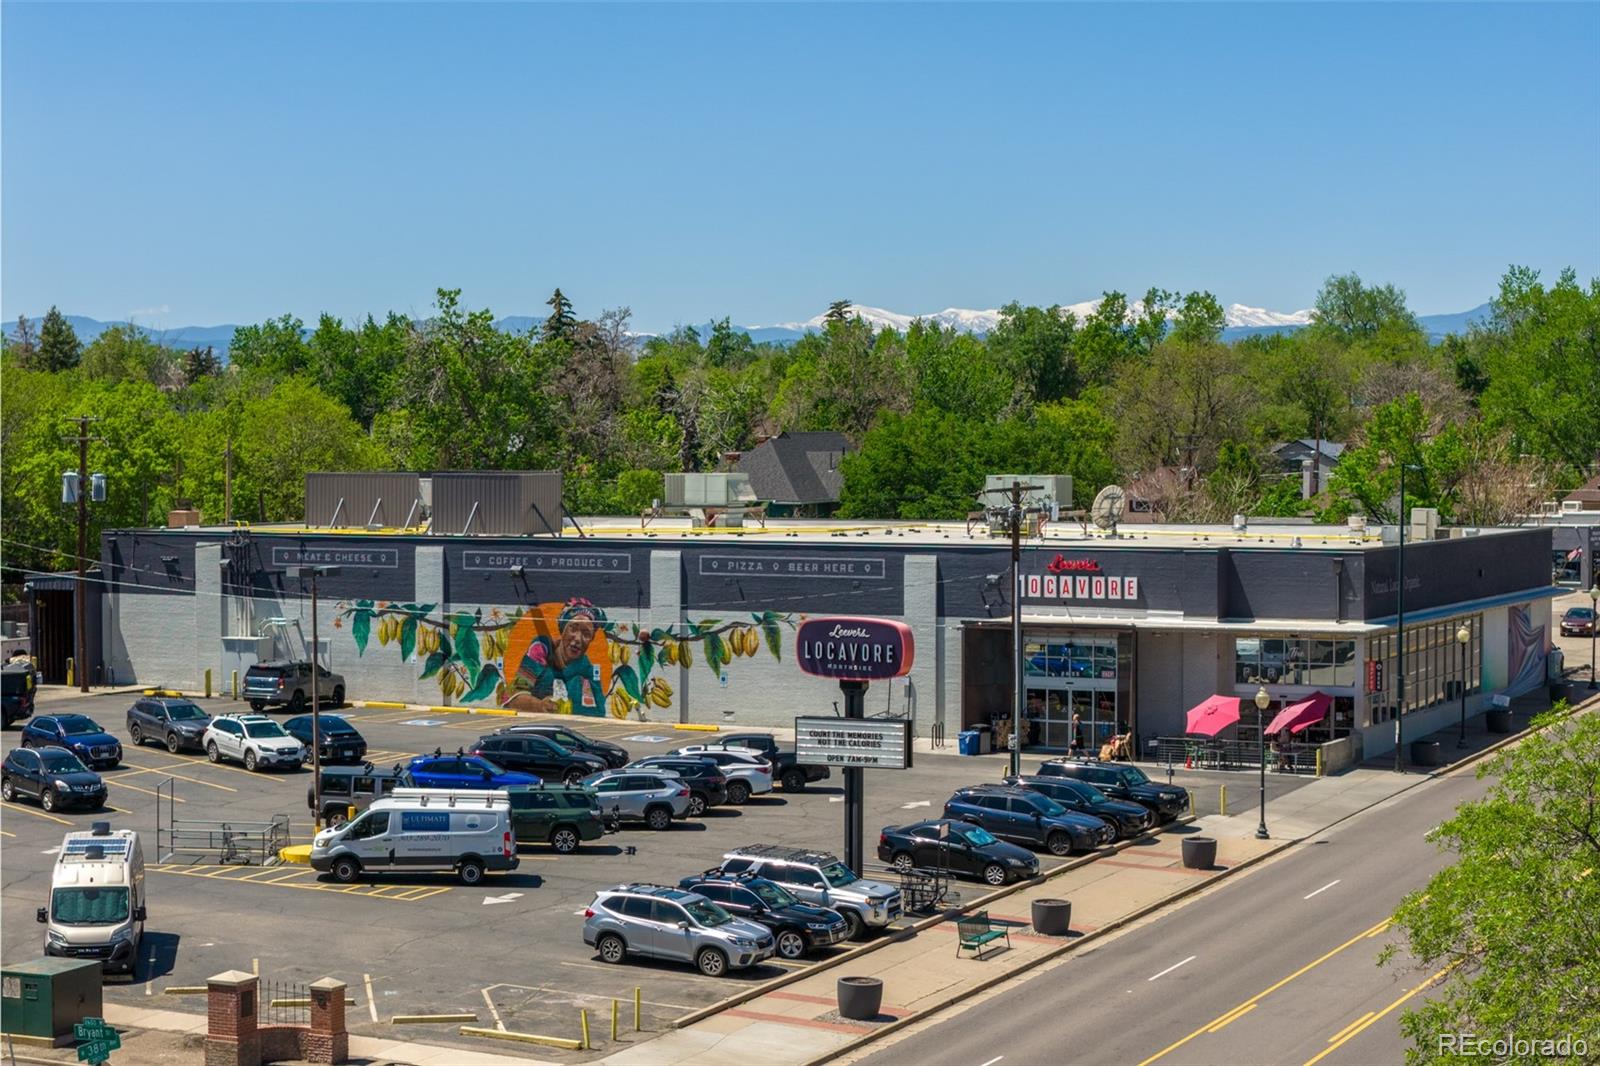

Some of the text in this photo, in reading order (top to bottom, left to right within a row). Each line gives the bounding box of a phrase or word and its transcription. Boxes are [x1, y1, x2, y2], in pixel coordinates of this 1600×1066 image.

[297, 552, 321, 561] MEAT
[335, 553, 373, 562] CHEESE
[488, 556, 529, 566] COFFEE
[551, 557, 603, 567] PRODUCE
[727, 561, 764, 571] PIZZA
[788, 562, 855, 573] BEER HERE
[1021, 578, 1134, 597] OCAVORE
[804, 640, 893, 664] LOCAVORE
[809, 730, 883, 740] COUNT THE MEMORIES
[834, 739, 847, 747] THE
[848, 740, 882, 748] CALORIES
[827, 754, 844, 762] OPEN
[78, 1026, 104, 1039] Bryant
